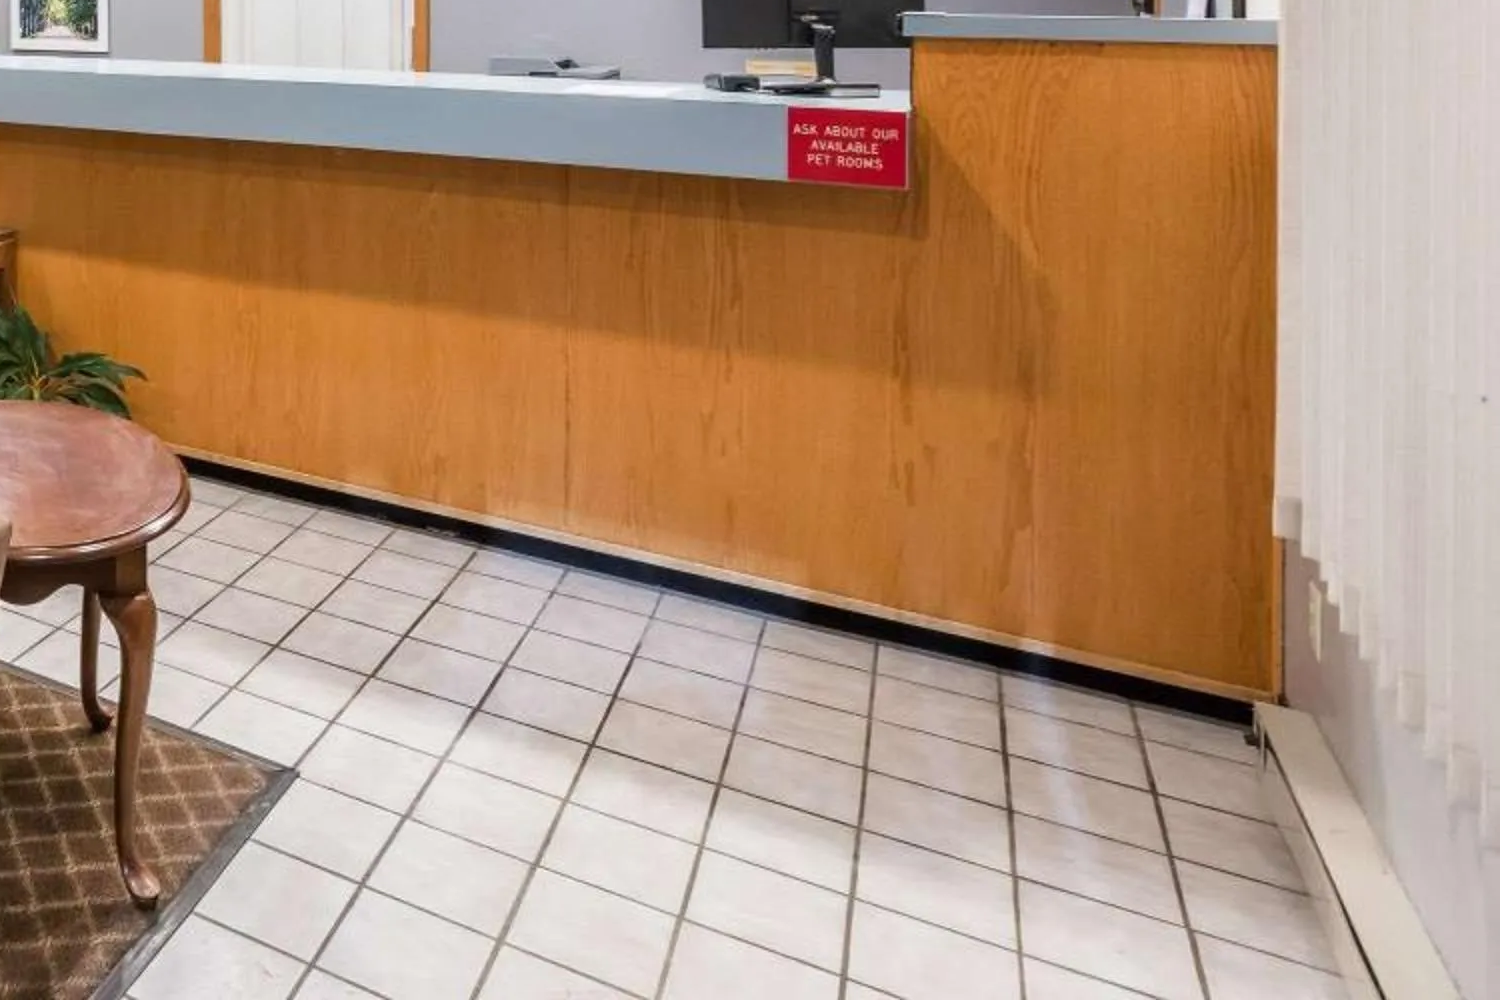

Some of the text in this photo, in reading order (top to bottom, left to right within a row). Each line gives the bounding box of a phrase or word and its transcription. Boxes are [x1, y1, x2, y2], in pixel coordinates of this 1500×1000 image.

[793, 123, 899, 140] ASK ABOUT OUR
[810, 140, 879, 155] AVAILABLE
[807, 153, 884, 170] PET ROOMS
